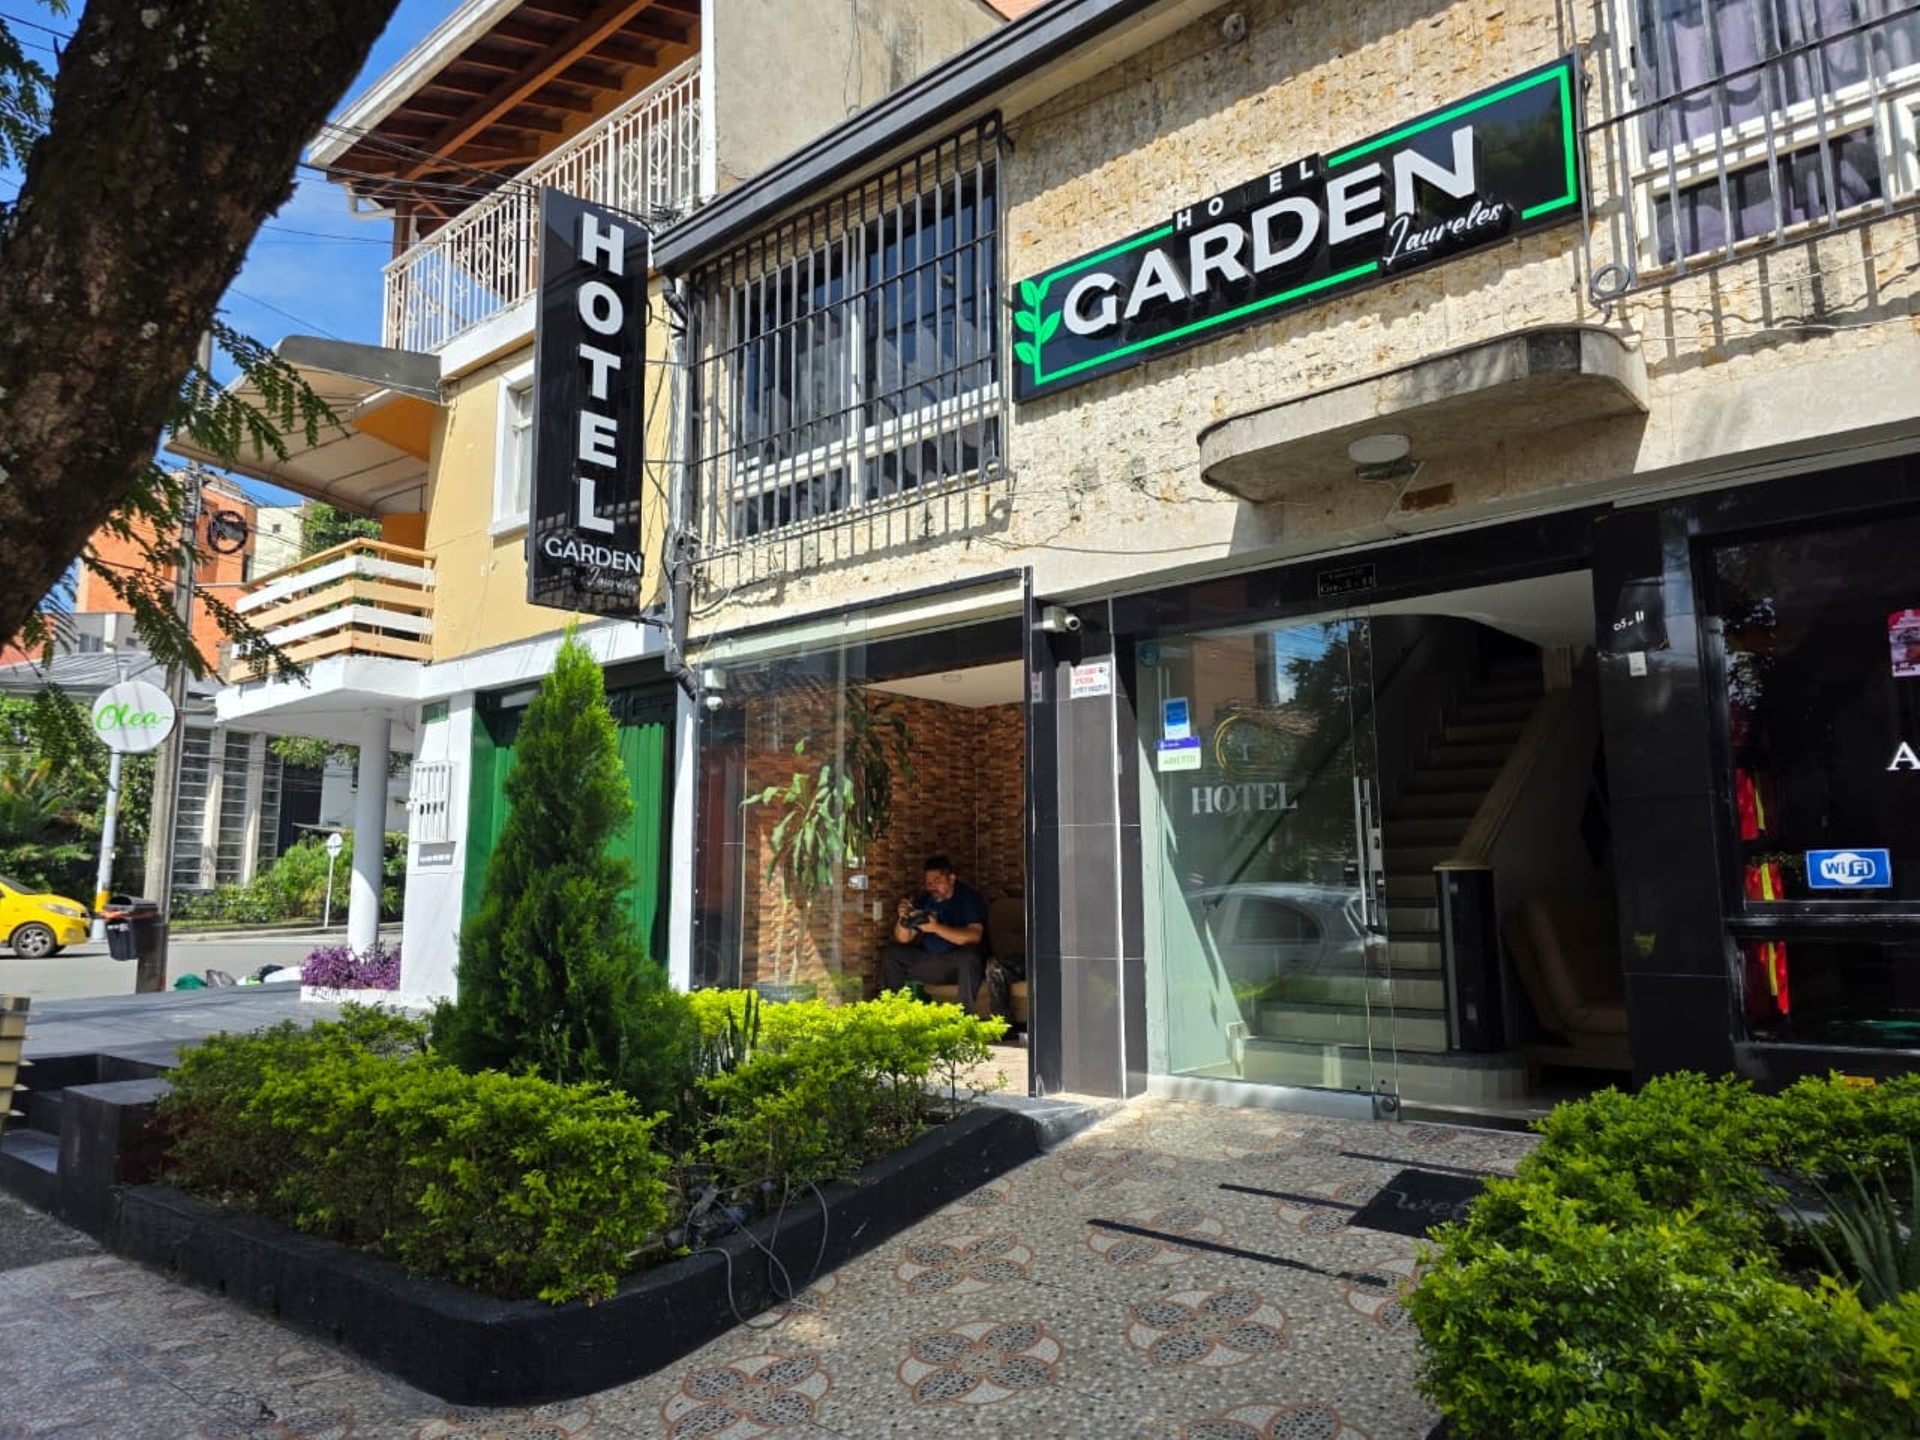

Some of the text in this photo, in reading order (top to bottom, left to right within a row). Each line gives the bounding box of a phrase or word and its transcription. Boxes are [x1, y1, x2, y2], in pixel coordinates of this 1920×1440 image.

[1176, 161, 1314, 231] HOEL
[1063, 126, 1476, 336] GARDEN
[1383, 201, 1503, 266] Laureles
[577, 212, 625, 535] HOTEL
[544, 537, 642, 575] GARDEN
[1191, 781, 1299, 816] HOTEL
